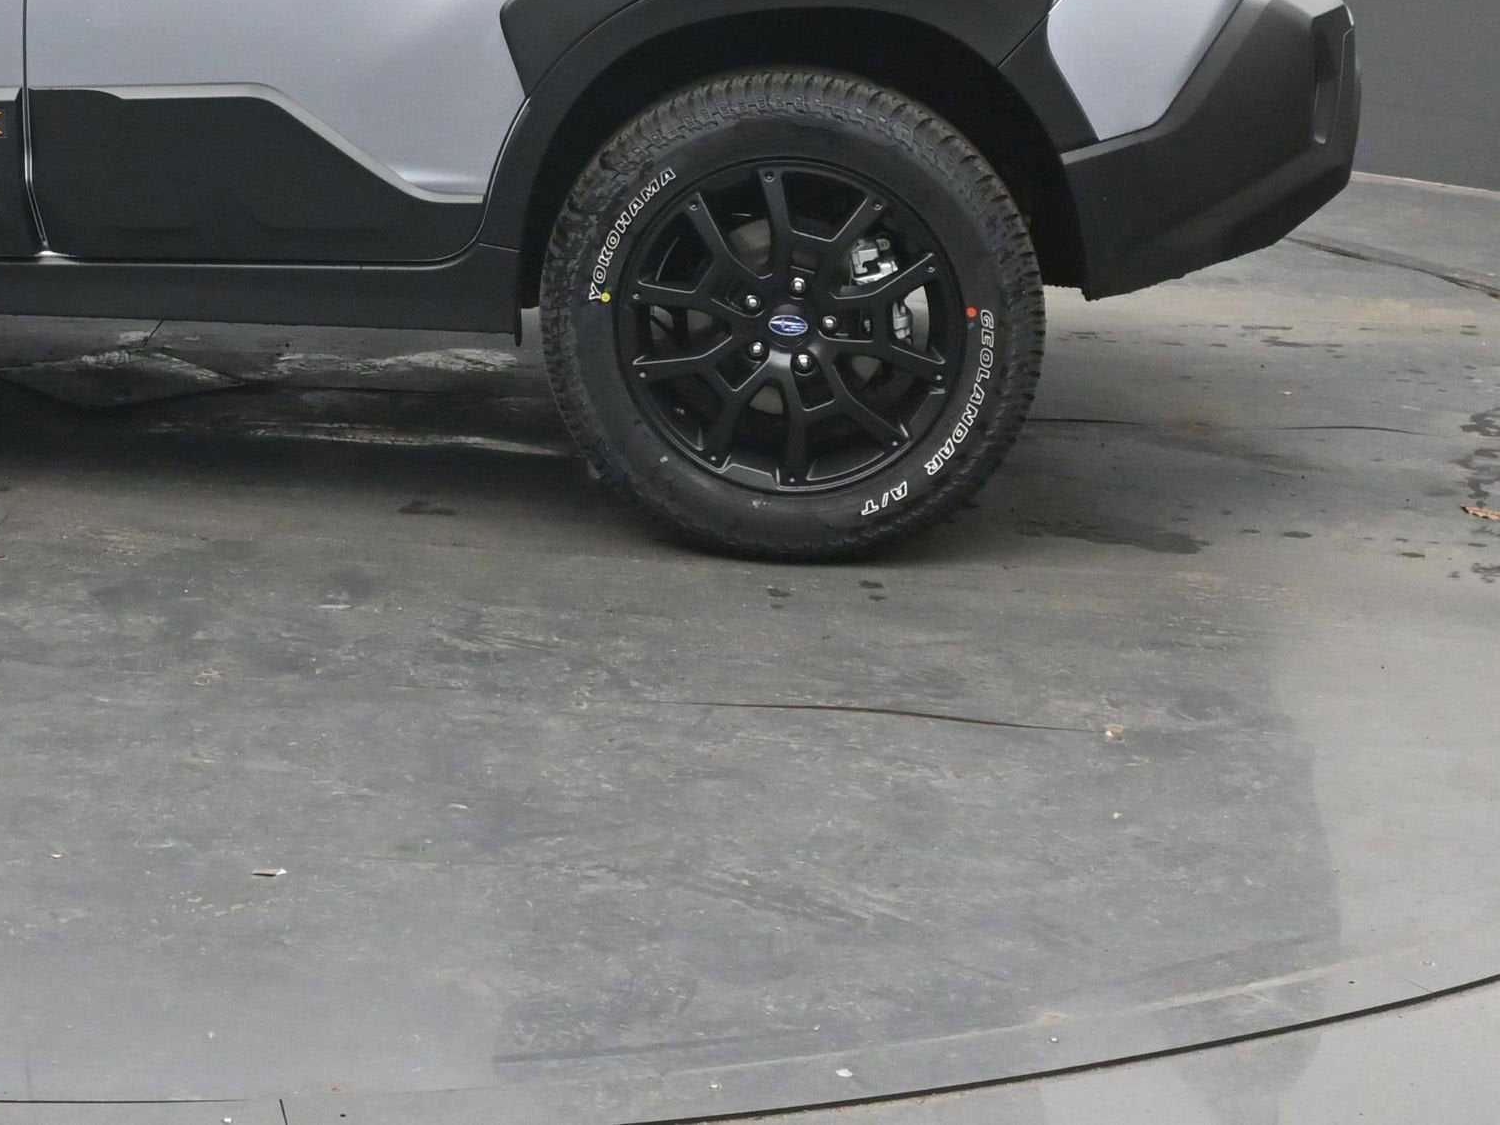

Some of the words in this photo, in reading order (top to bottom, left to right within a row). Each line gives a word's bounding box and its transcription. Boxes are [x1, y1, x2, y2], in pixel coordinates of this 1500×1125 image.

[588, 167, 677, 300] YOKOHAMA
[923, 309, 995, 476] GEOLANDAR
[860, 481, 909, 515] A/T
